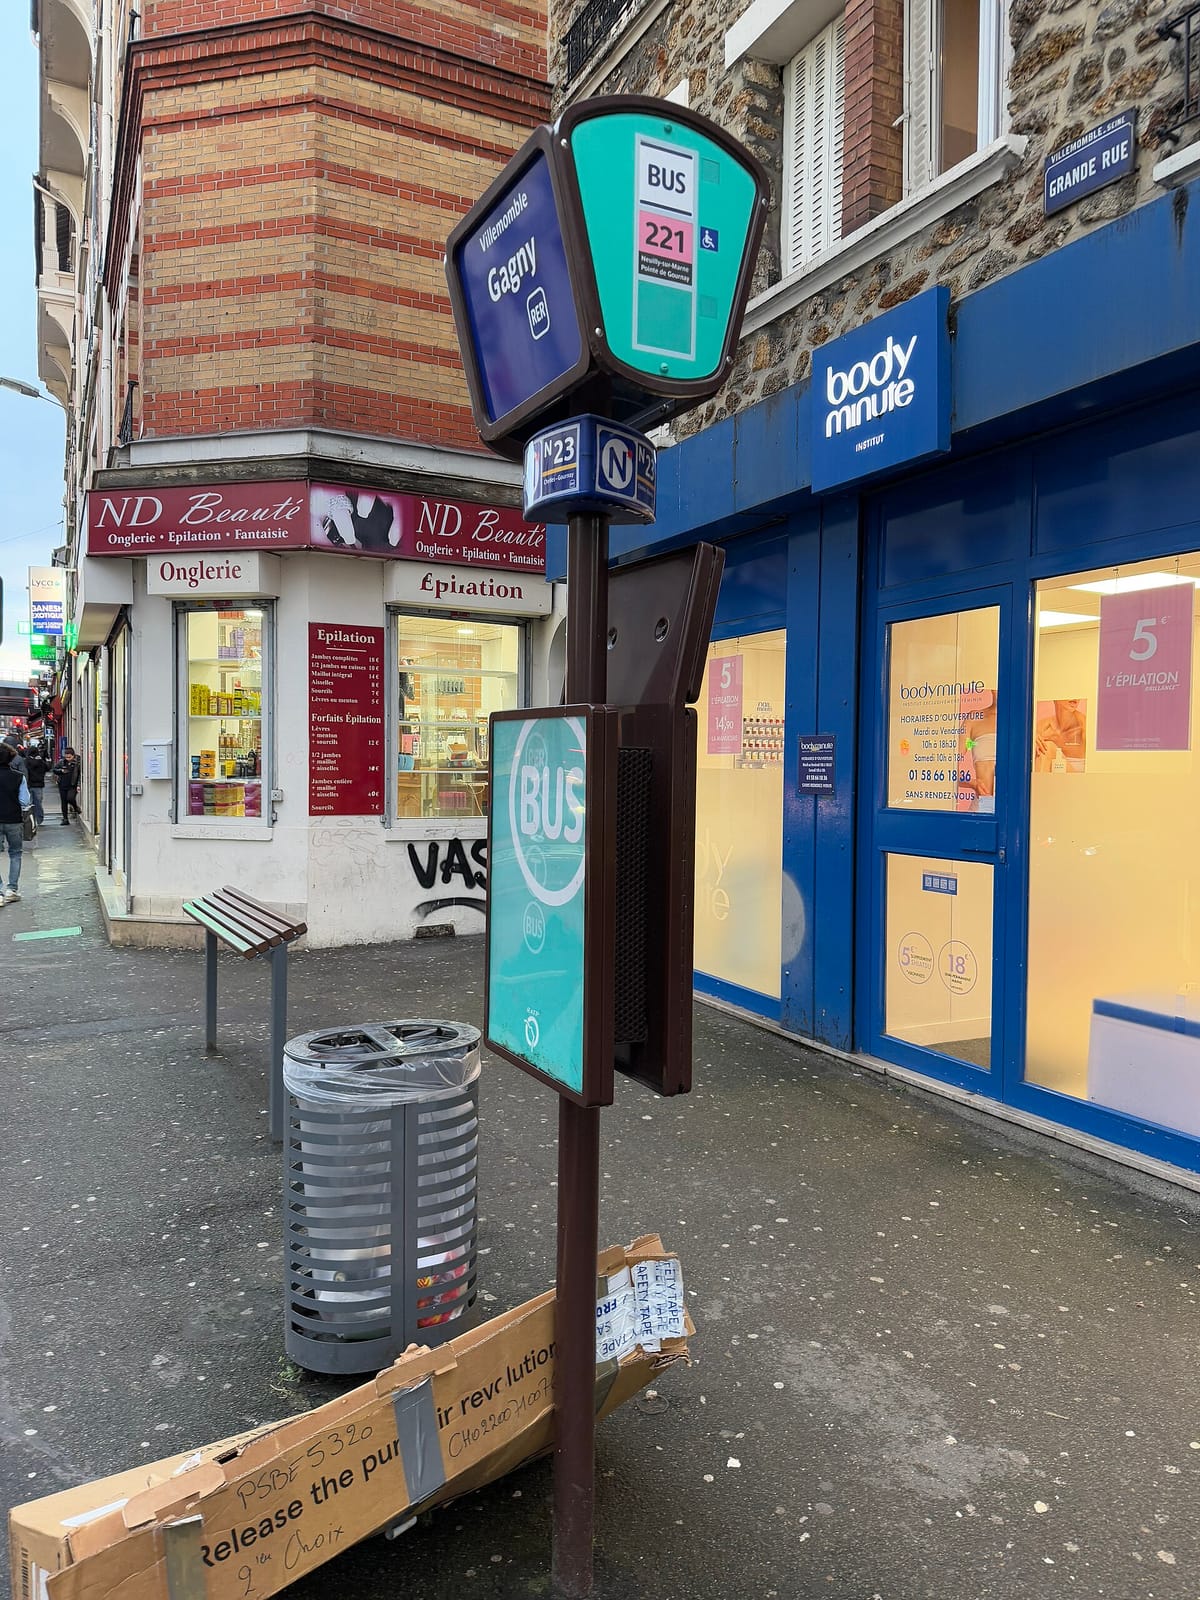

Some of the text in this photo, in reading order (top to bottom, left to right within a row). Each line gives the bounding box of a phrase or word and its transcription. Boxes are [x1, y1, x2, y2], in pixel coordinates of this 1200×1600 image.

[648, 164, 686, 194] BUS
[1050, 140, 1128, 198] GRANDE RUE
[479, 192, 528, 252] Villemomble
[645, 222, 684, 254] 221
[488, 236, 537, 302] Gagny
[641, 256, 689, 272] Neuilly-sur-Marne
[641, 265, 690, 283] Pointe de Gournay
[530, 301, 545, 326] RER
[827, 335, 918, 405] body
[826, 378, 915, 438] minute
[855, 433, 885, 452] INSTITUT
[94, 492, 304, 528] ND Beauté
[416, 501, 546, 548] ND Beauté
[108, 528, 288, 547] Onglerie Epilation Fantaisie
[416, 541, 545, 566] Onglerie Epilation Fantaisie
[160, 560, 242, 588] Onglerie
[318, 629, 375, 645] Epilation
[901, 680, 985, 700] bodyminute
[1106, 672, 1178, 688] L'ÉPILATION
[312, 712, 381, 725] Forfaits Épilation
[901, 715, 933, 723] HORAIRES
[914, 728, 930, 736] Mardi
[940, 727, 966, 735] Vendredi
[922, 740, 932, 748] 10h
[939, 740, 956, 748] 18h30
[914, 754, 935, 762] Samedi
[937, 754, 947, 762] 10h
[909, 770, 971, 781] 01 58 66 18 36
[521, 765, 584, 844] BUS
[906, 791, 975, 801] SANS RENDEZ-VOUS
[526, 915, 543, 939] BUS
[640, 1305, 652, 1336] TAPE
[310, 1469, 354, 1505] the
[284, 1525, 344, 1570] Choix
